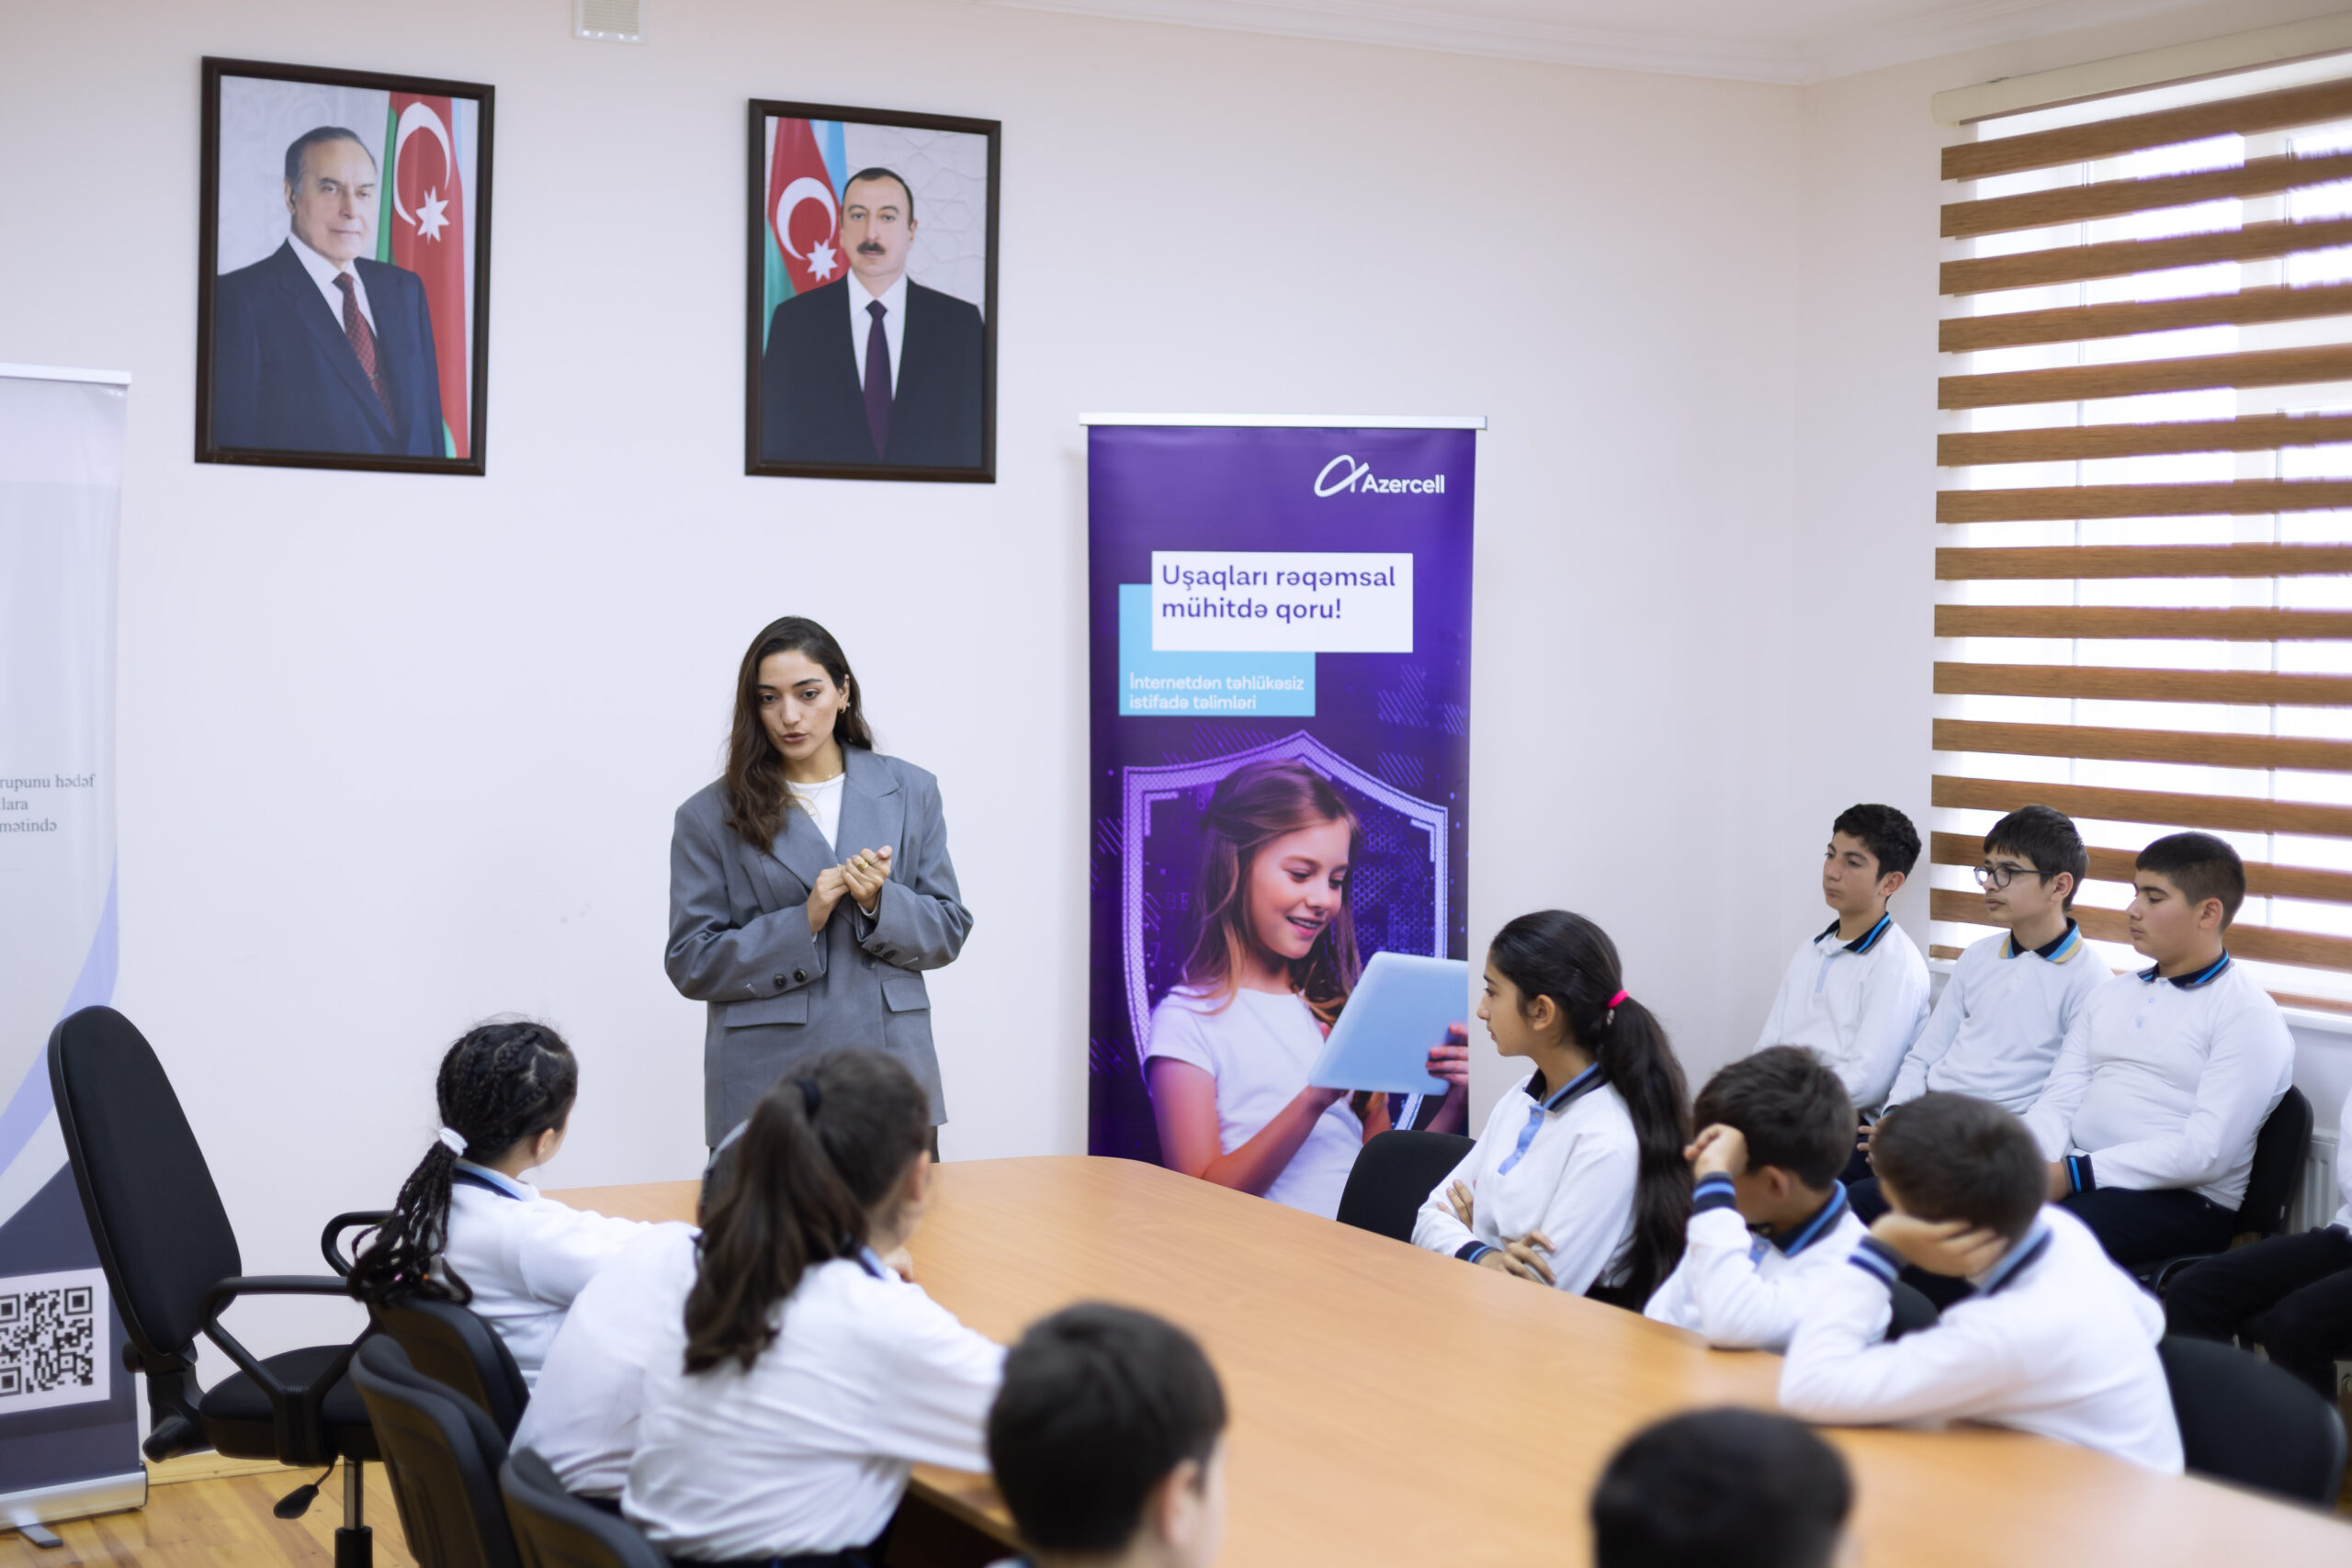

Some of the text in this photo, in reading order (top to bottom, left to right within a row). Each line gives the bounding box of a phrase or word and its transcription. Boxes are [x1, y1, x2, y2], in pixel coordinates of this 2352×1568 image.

[1361, 473, 1445, 494] Azercell
[1162, 564, 1396, 592] Uşaqları rəqəmsal
[1162, 596, 1341, 624] mühitdə qoru!
[1129, 671, 1305, 691] İnternetdən təhlükəsiz
[1129, 694, 1257, 710] istifadə təlimləri
[55, 773, 96, 788] hədəf
